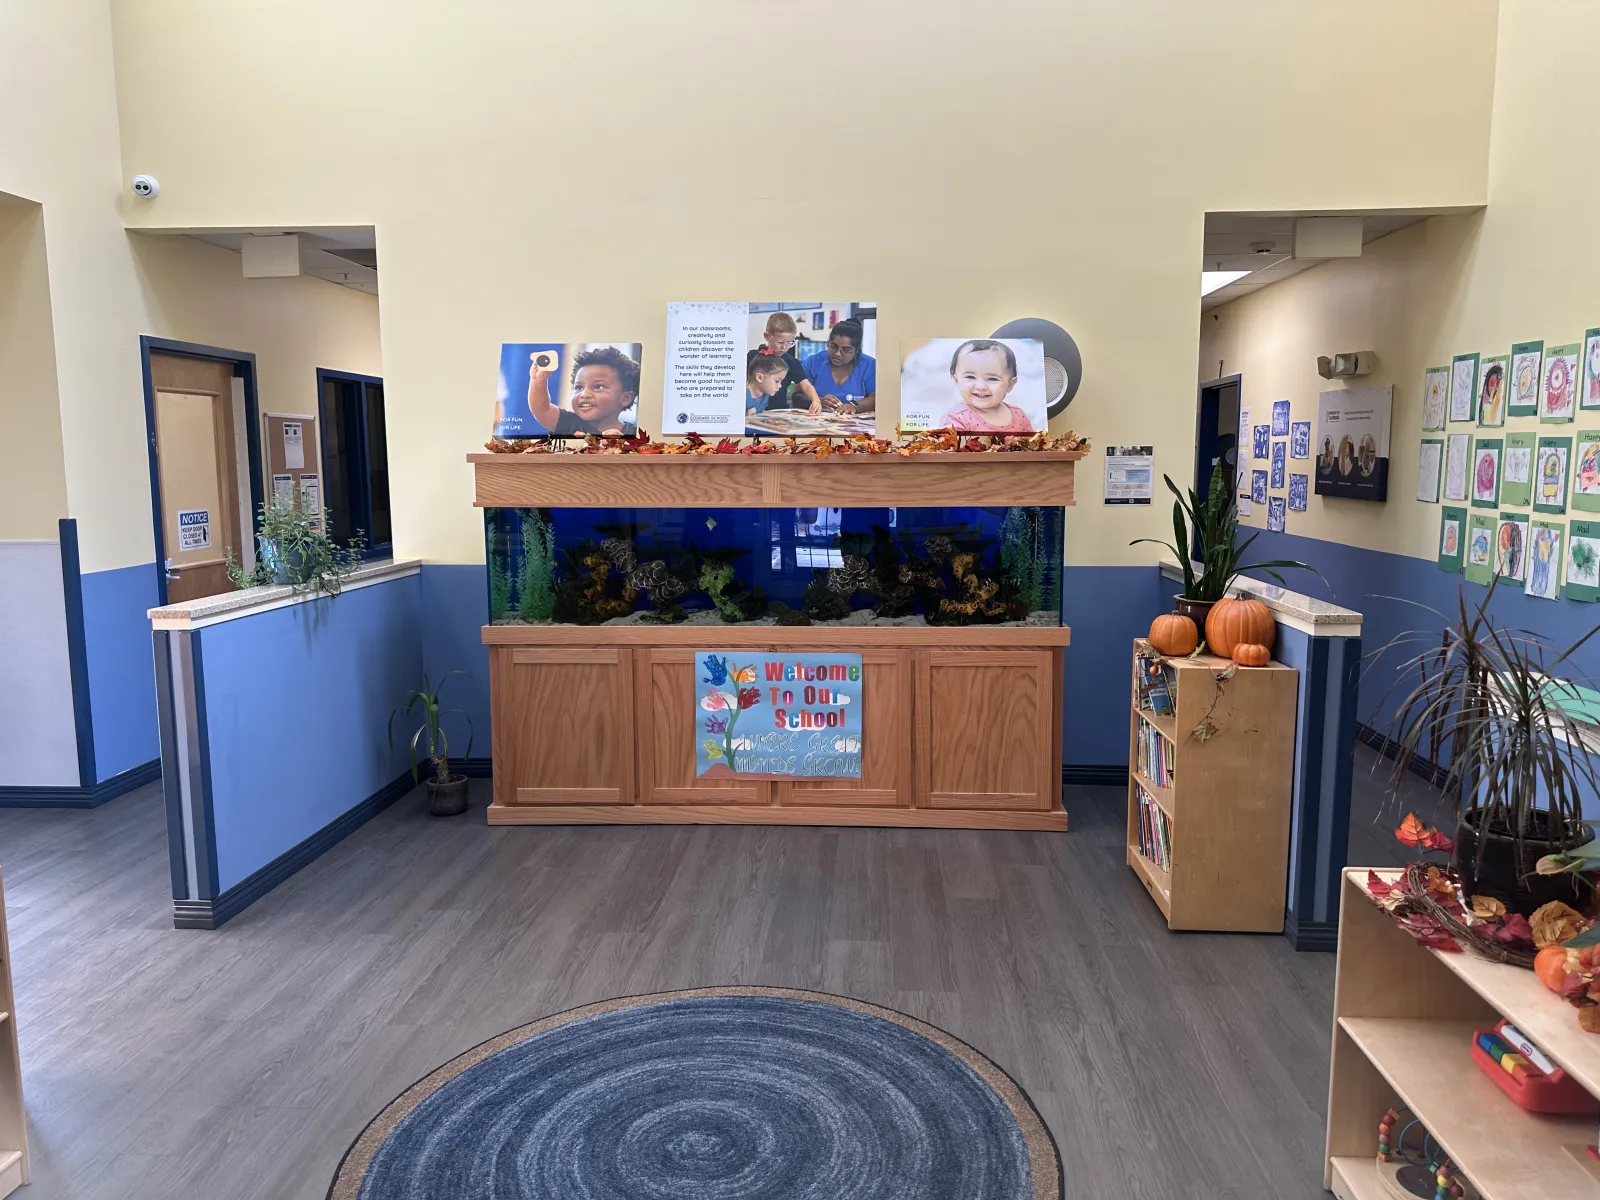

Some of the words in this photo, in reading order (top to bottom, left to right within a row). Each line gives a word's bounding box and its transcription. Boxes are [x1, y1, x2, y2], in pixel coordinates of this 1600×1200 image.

[182, 513, 208, 524] NOTICE
[183, 532, 198, 540] CLOSED
[1577, 524, 1590, 533] Mad
[764, 662, 860, 682] Welcome
[769, 686, 794, 706] To
[803, 685, 839, 705] Our
[774, 708, 845, 729] School
[740, 732, 800, 752] WHERE
[808, 732, 861, 755] GREAT
[735, 755, 797, 774] MINDS
